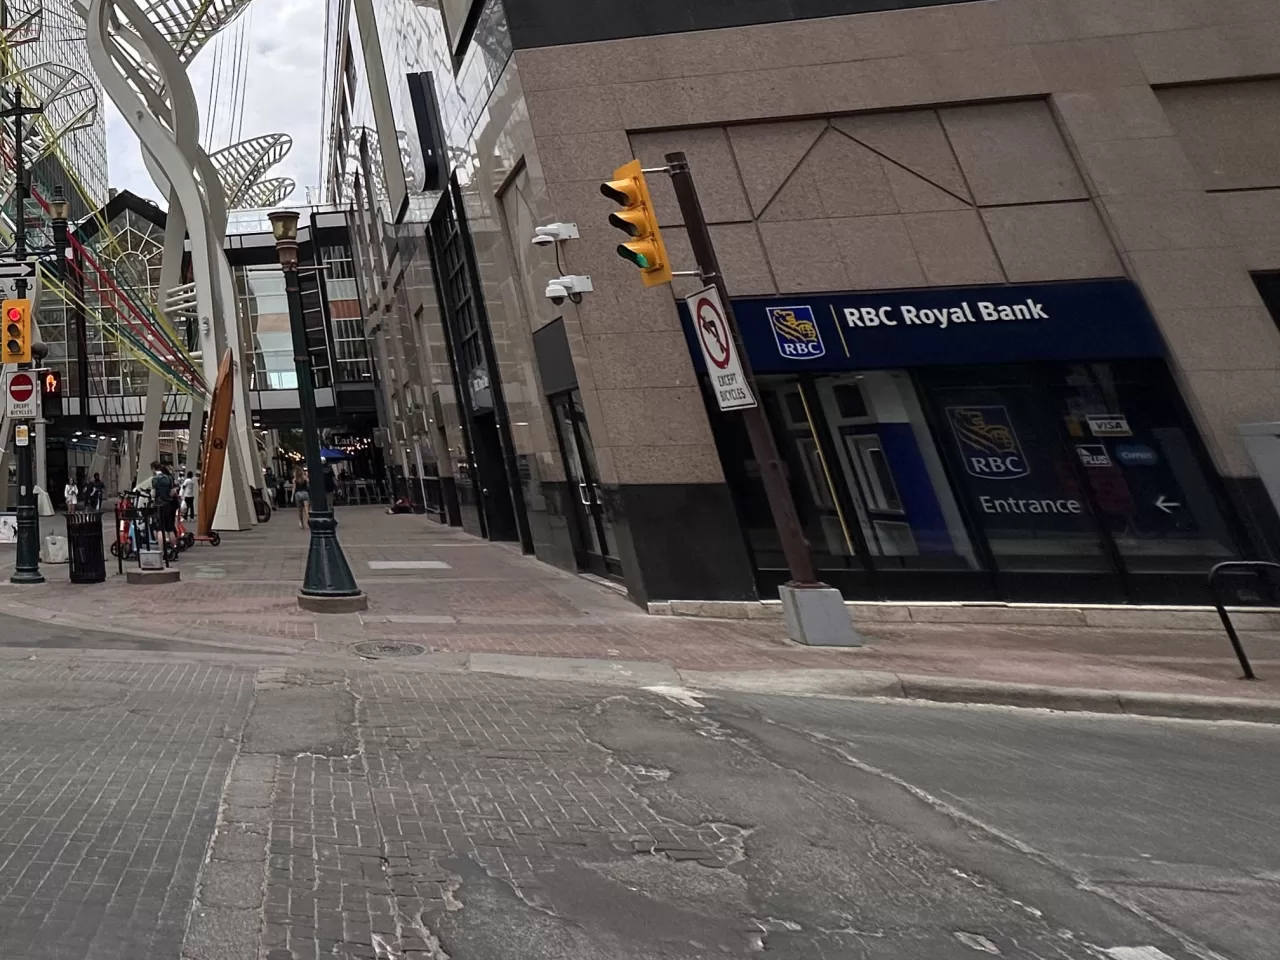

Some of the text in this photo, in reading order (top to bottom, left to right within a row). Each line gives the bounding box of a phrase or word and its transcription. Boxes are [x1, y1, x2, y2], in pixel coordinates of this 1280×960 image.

[843, 298, 1050, 329] RBC Royal Bank
[783, 341, 821, 355] RBC
[717, 372, 738, 386] EXCEPT
[719, 388, 746, 401] BICYCLES
[1095, 421, 1124, 431] VISA
[971, 456, 1024, 473] RBC
[1082, 455, 1108, 465] PLUS
[979, 495, 1081, 514] Entrance
